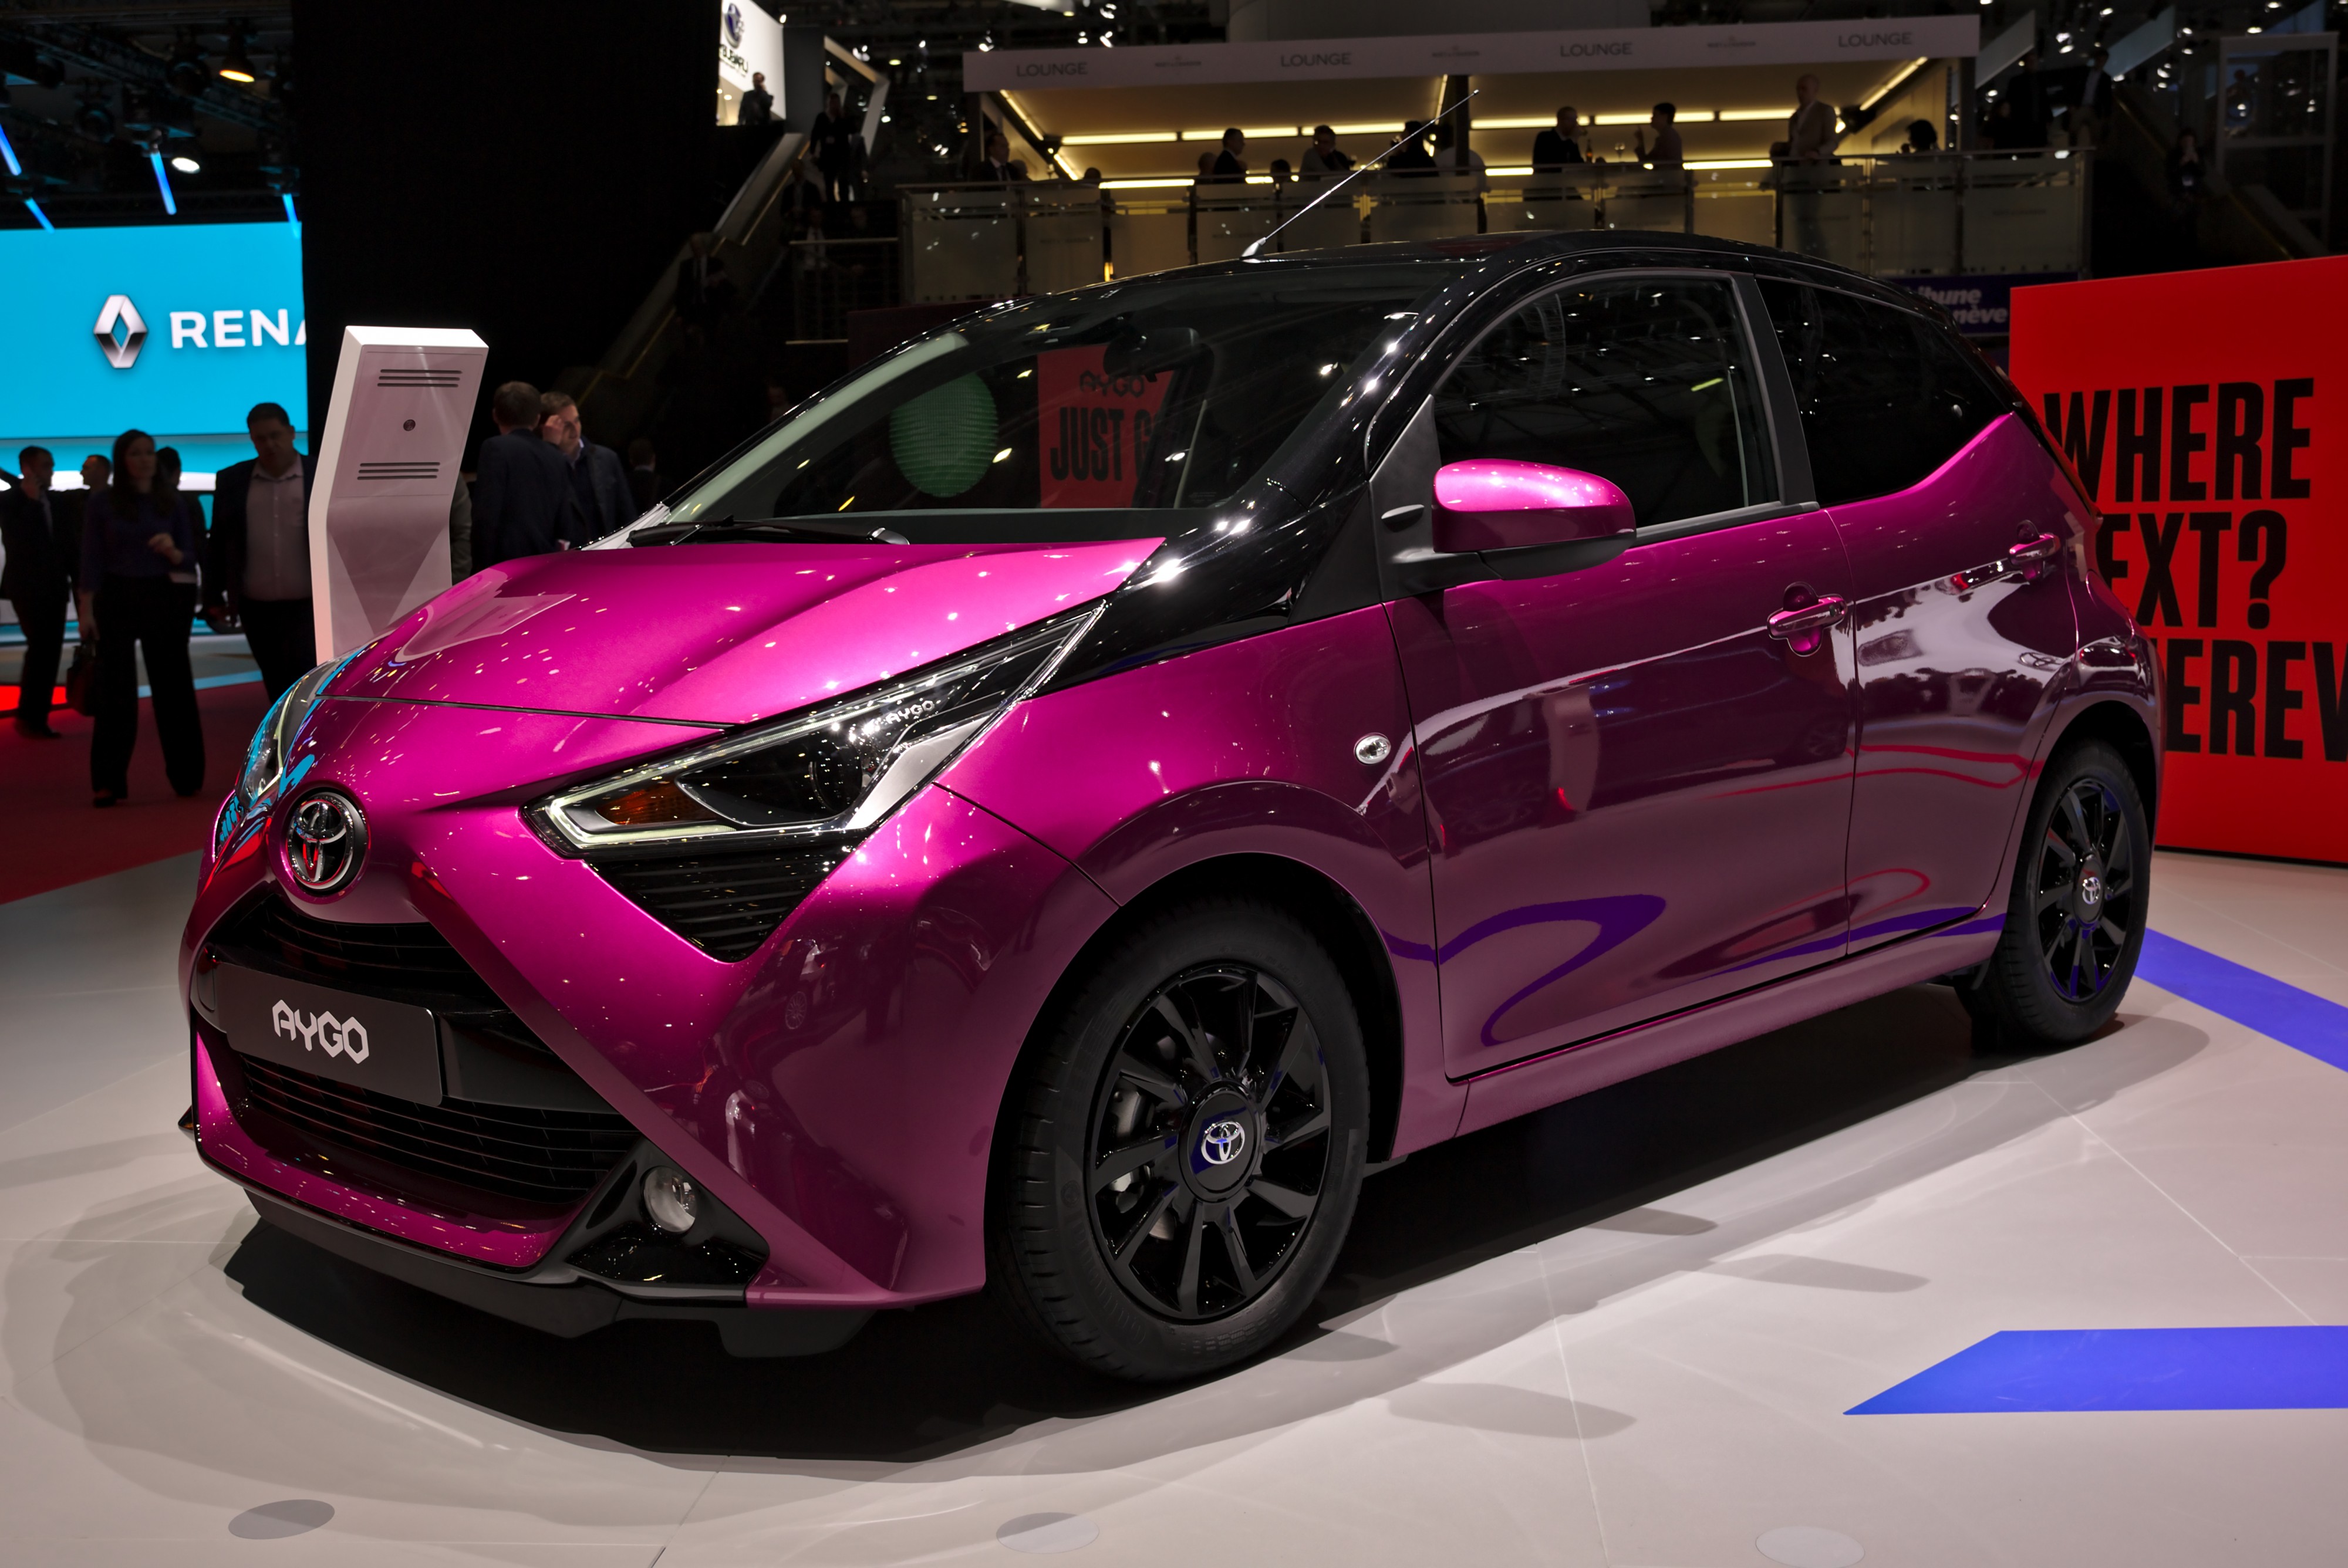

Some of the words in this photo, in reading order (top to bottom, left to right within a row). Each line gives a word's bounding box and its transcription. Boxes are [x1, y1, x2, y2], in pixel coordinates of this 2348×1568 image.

[1560, 42, 1632, 58] LOUNGE
[1838, 32, 1912, 48] LOUNGE
[1016, 62, 1088, 77] LOUNGE
[1280, 53, 1352, 67] LOUNGE
[1080, 370, 1144, 398] AYGO
[1050, 407, 1124, 482] JUST
[2043, 377, 2314, 503] WHERE
[885, 700, 935, 724] AYGO
[2149, 638, 2348, 762] EREV
[272, 999, 370, 1064] AYGO
